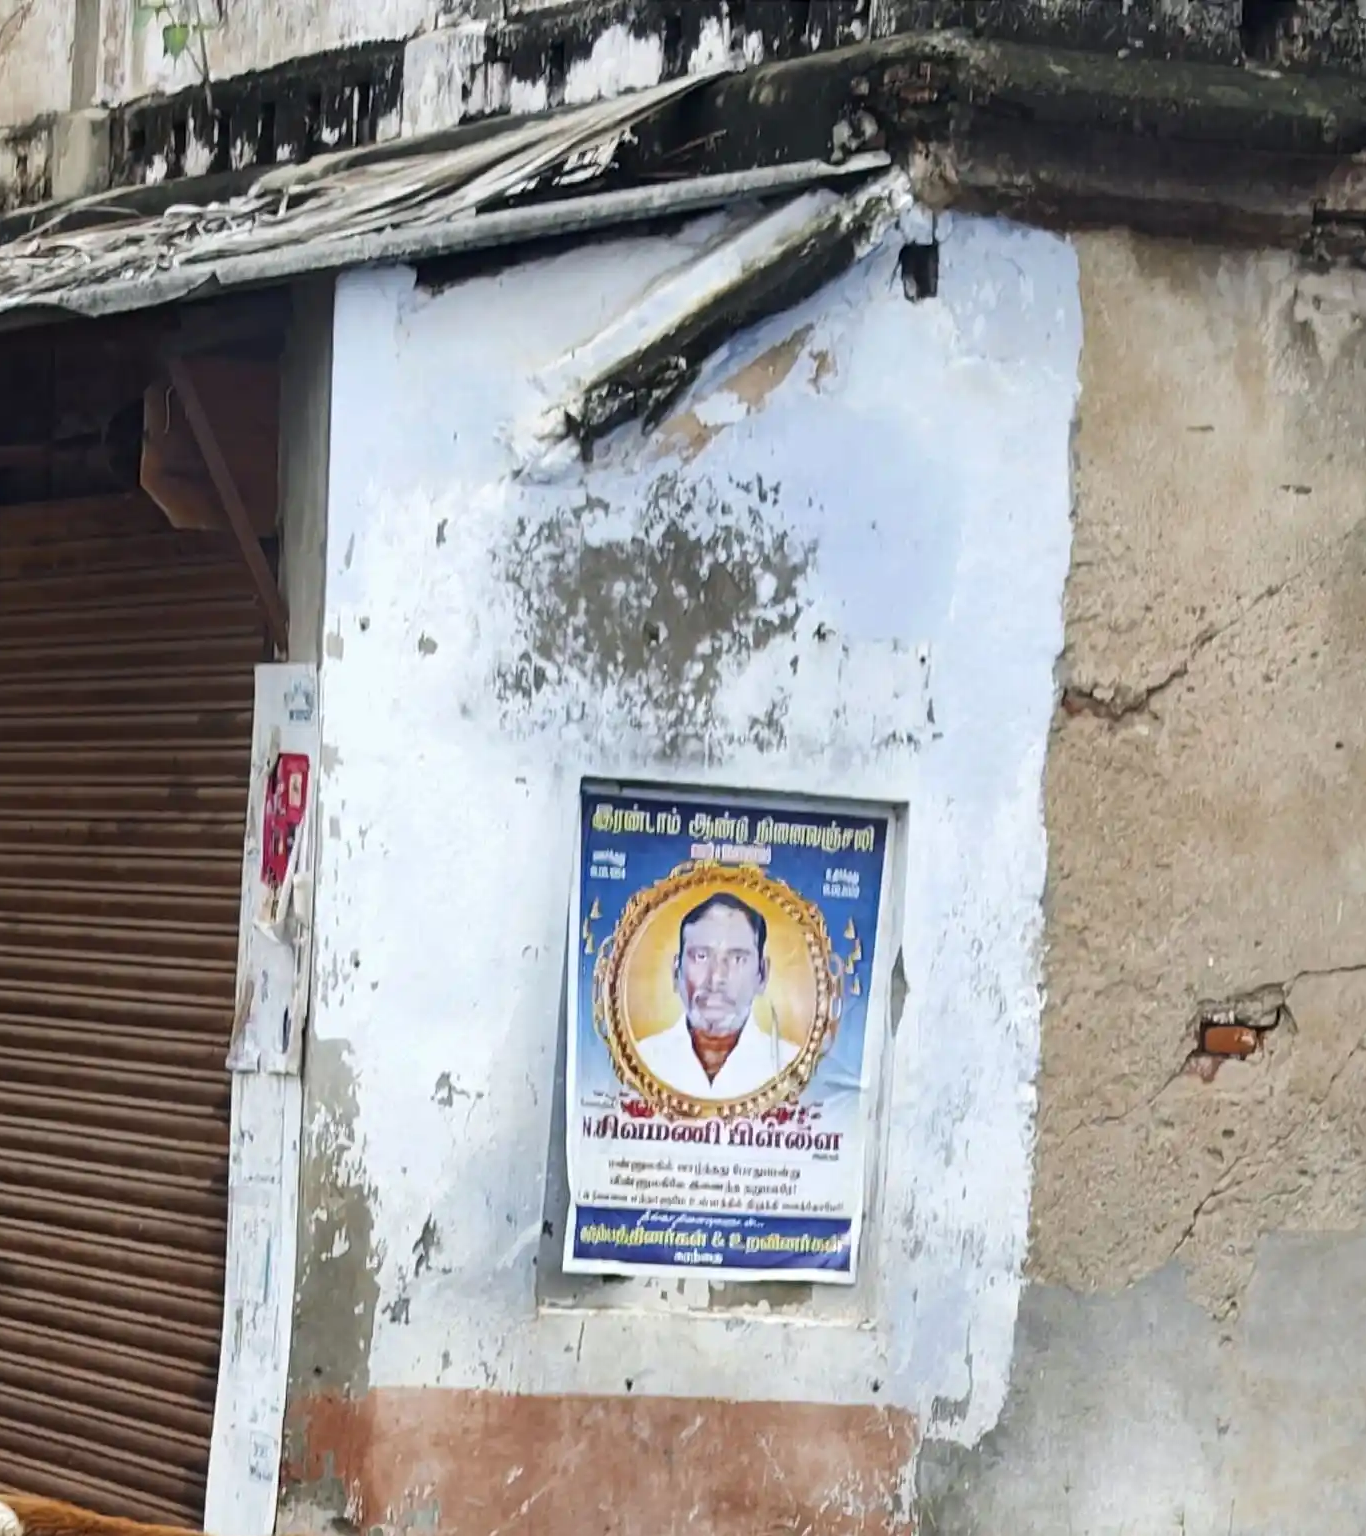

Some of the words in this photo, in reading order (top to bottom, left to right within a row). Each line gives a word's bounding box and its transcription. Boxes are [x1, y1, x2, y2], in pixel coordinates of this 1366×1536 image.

[592, 803, 681, 836] இரண்டாம்
[688, 811, 749, 842] ஆண்டு
[711, 1231, 725, 1248] &
